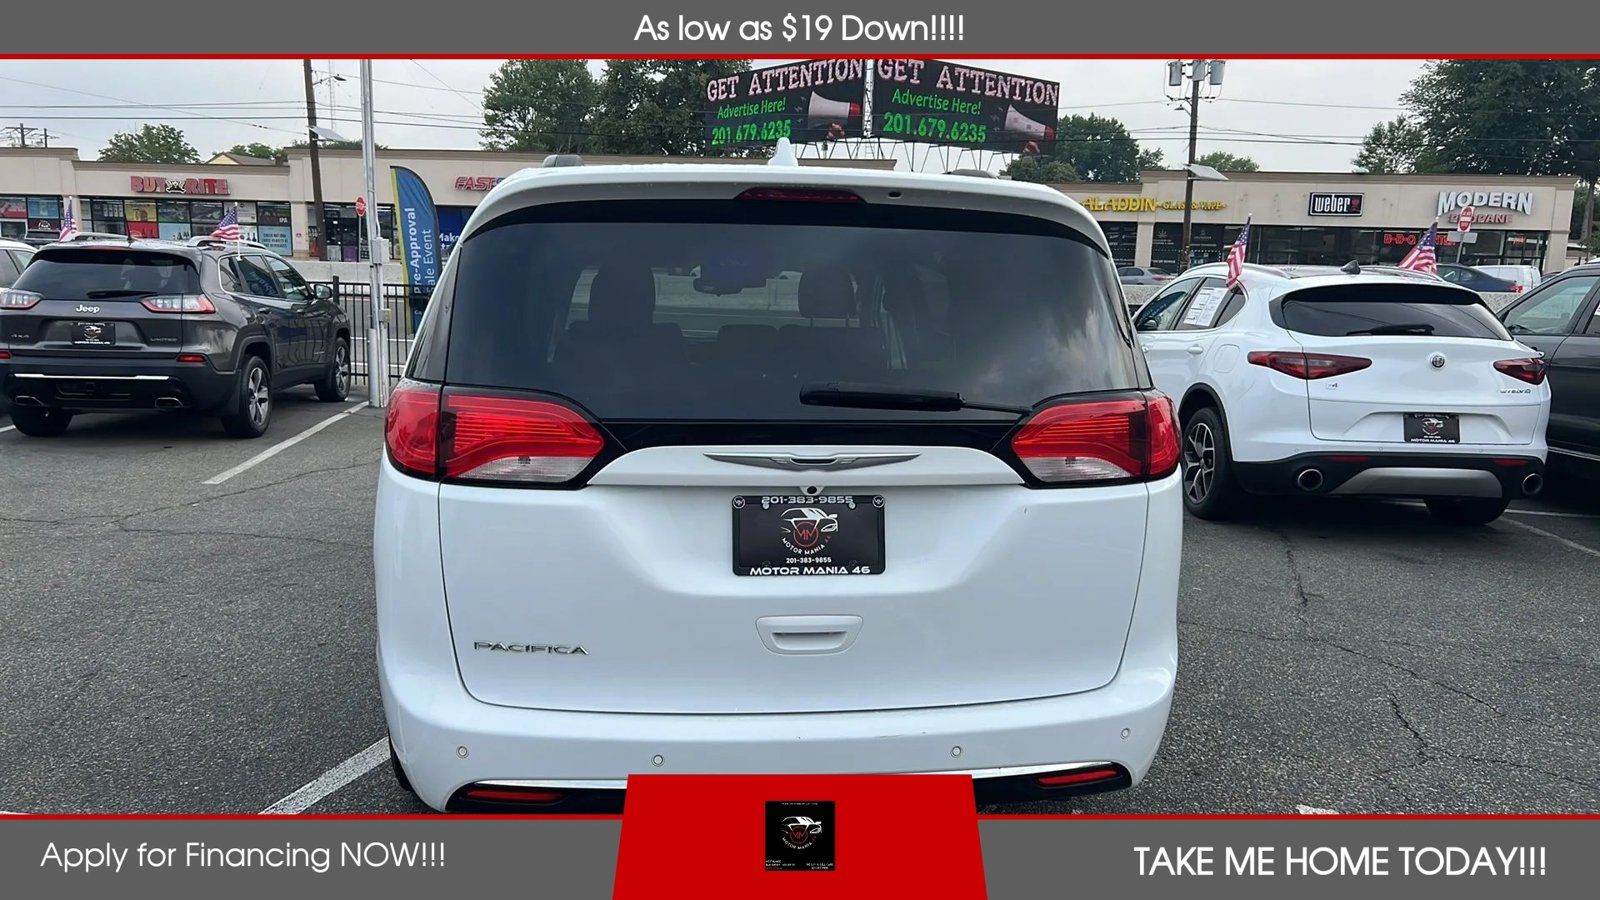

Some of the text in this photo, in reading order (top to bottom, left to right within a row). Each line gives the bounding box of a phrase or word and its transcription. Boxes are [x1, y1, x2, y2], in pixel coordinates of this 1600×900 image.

[707, 58, 865, 102] GET ATTENTION
[877, 58, 1060, 107] GET ATTENTION
[717, 97, 787, 120] Advertise Here!
[892, 89, 982, 115] Advertise Here!
[711, 119, 792, 147] 201.679.6235
[883, 111, 986, 143] 201.679.6235
[131, 176, 230, 195] BUY RITE
[1081, 196, 1157, 213] ALADDIN
[1315, 194, 1351, 213] weber
[1437, 191, 1534, 216] MODERN
[404, 207, 421, 294] Pre-Approval
[421, 229, 436, 265] Event
[75, 304, 101, 314] Jeep
[761, 495, 854, 504] 201-383-9855
[781, 537, 803, 554] MOTOR
[804, 543, 826, 555] MANIA
[750, 566, 871, 575] MOTOR MANIA 46
[786, 556, 832, 564] 201-383-9855
[474, 641, 588, 655] PACIFICA
